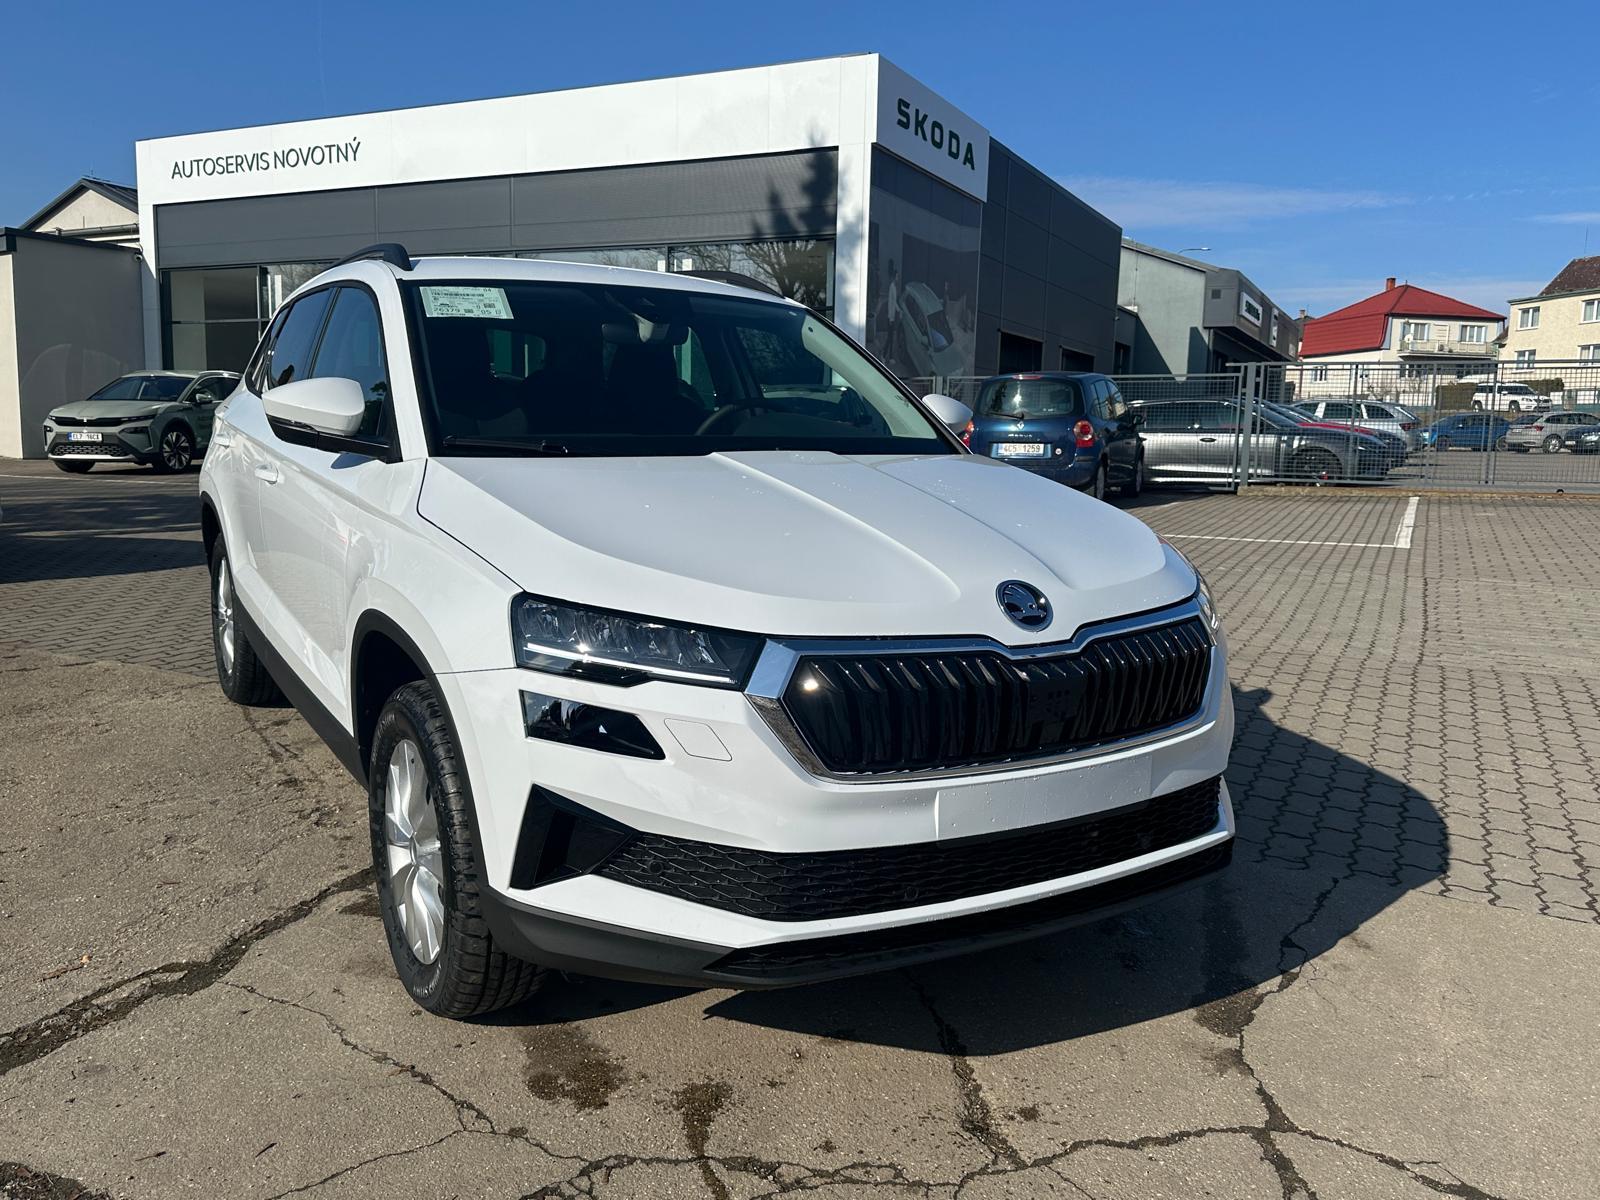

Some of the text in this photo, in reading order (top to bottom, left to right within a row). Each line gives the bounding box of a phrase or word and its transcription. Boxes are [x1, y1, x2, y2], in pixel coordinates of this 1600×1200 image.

[897, 98, 975, 170] SKODA
[171, 136, 361, 179] AUTOSERVIS NOVOTNÝ
[1022, 444, 1041, 453] 1259
